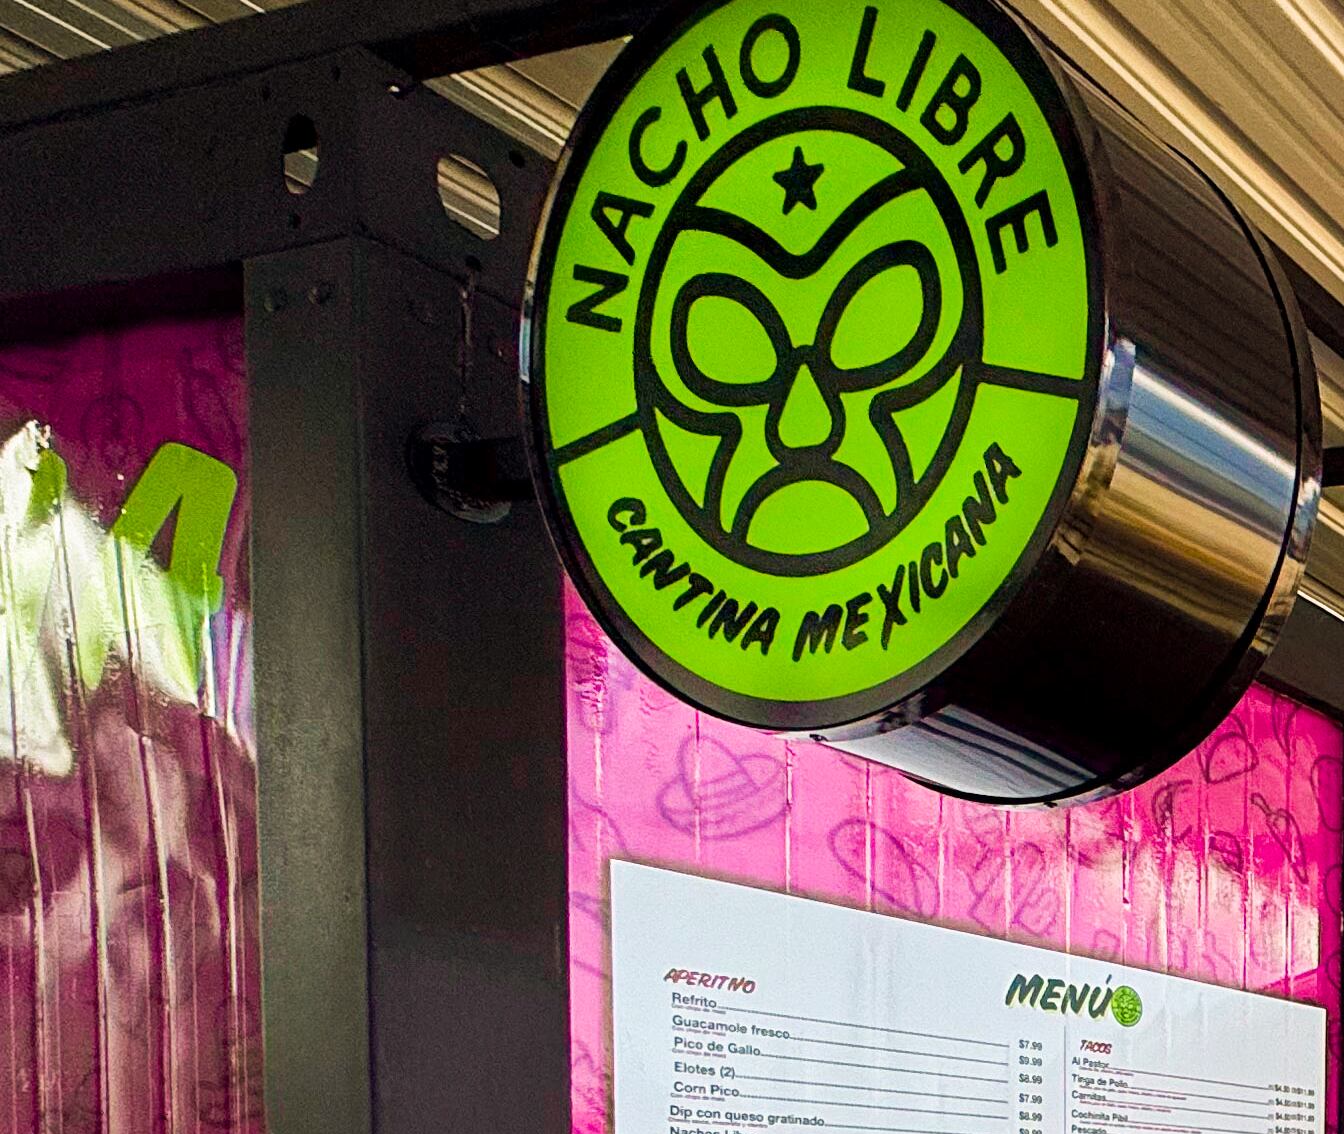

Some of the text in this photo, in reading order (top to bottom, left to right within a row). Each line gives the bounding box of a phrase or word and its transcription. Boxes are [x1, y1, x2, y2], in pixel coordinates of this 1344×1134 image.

[566, 4, 1060, 334] NACHO LIBRE
[606, 441, 1024, 663] CANTINA MEXICANA
[1005, 974, 1113, 1019] MENÚ
[672, 992, 1042, 1050] Refrito $7.99
[672, 1015, 747, 1033] Guacamole
[751, 1025, 790, 1039] fresco
[1019, 1056, 1042, 1066] $9.99
[674, 1037, 703, 1050] Pico
[707, 1040, 723, 1051] de
[728, 1043, 761, 1056] Gallo
[1080, 1040, 1112, 1054] TACOS
[673, 1081, 706, 1094] Corn
[710, 1084, 740, 1097] Pico
[674, 1062, 1042, 1104] Elotes (2) $7.99
[670, 1105, 692, 1118] Dip
[696, 1109, 721, 1119] con
[725, 1112, 764, 1126] queso
[768, 1114, 825, 1129] gratinado
